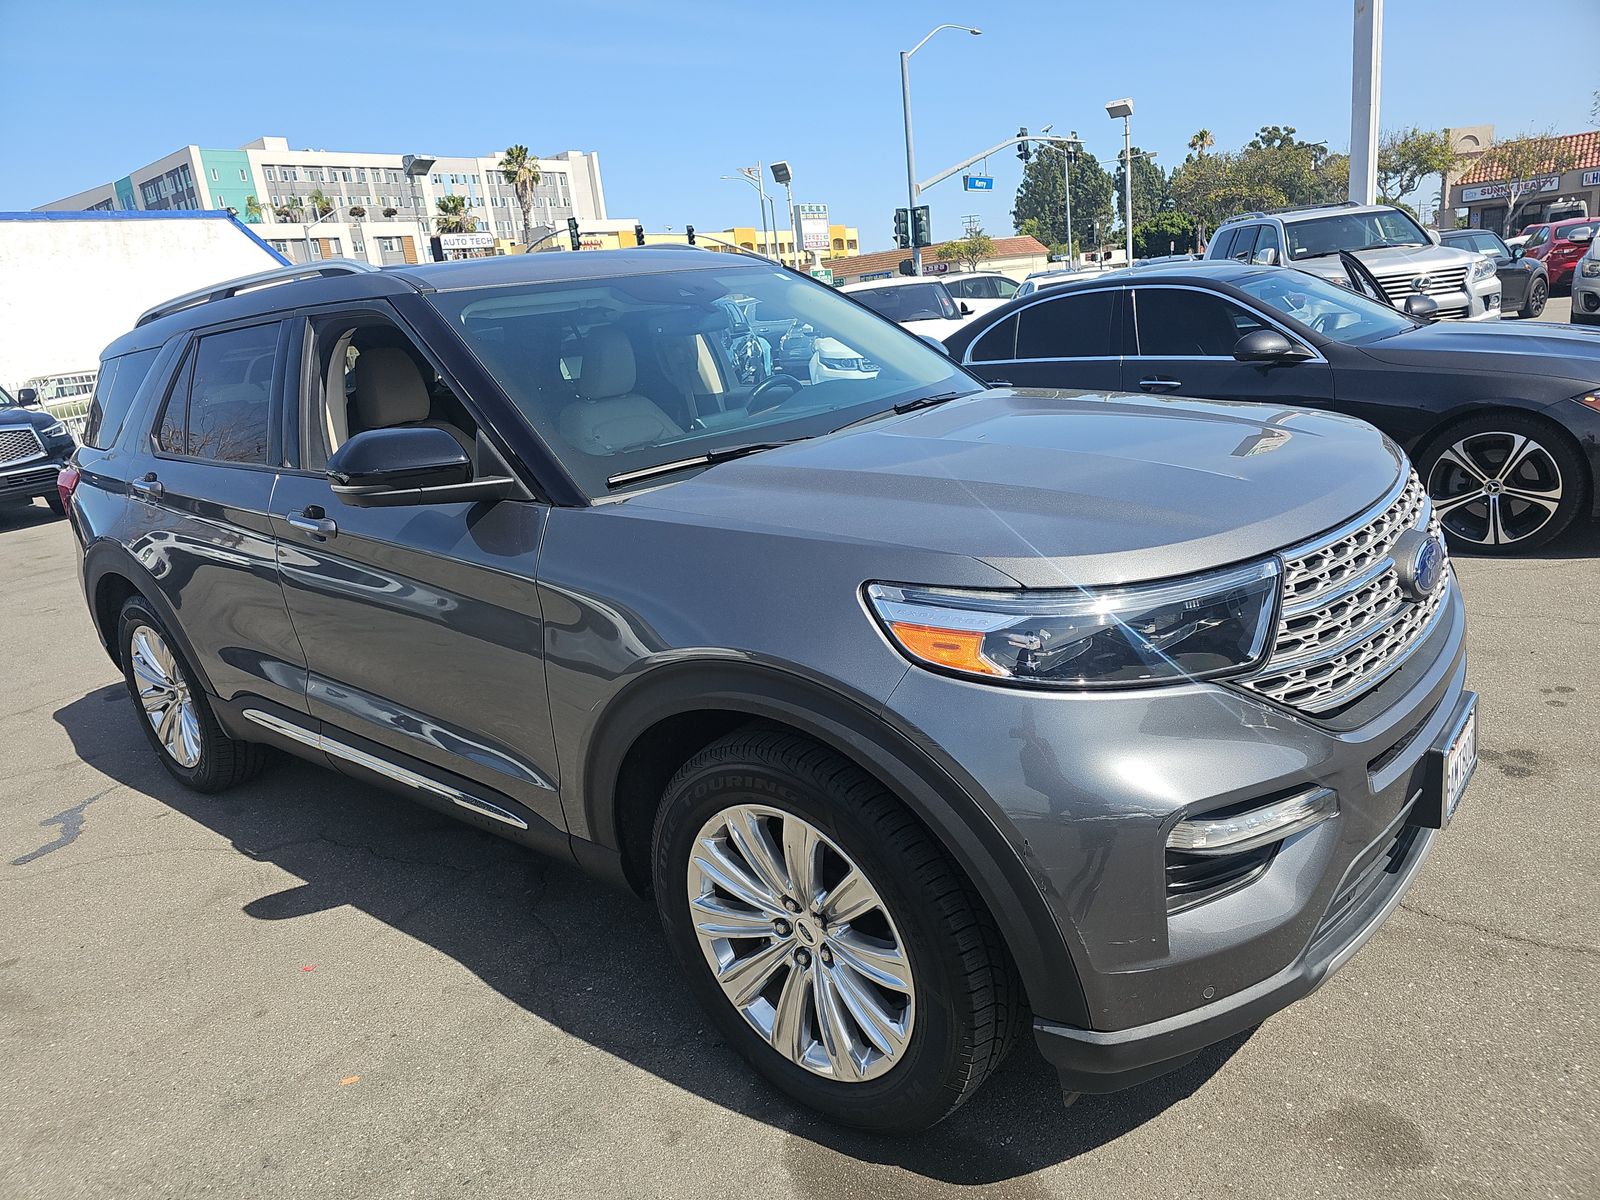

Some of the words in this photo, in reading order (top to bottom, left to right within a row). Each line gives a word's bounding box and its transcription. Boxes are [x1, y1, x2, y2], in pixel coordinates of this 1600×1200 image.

[443, 237, 467, 247] AUTO
[469, 236, 493, 245] TECH
[681, 775, 800, 808] TOURING
